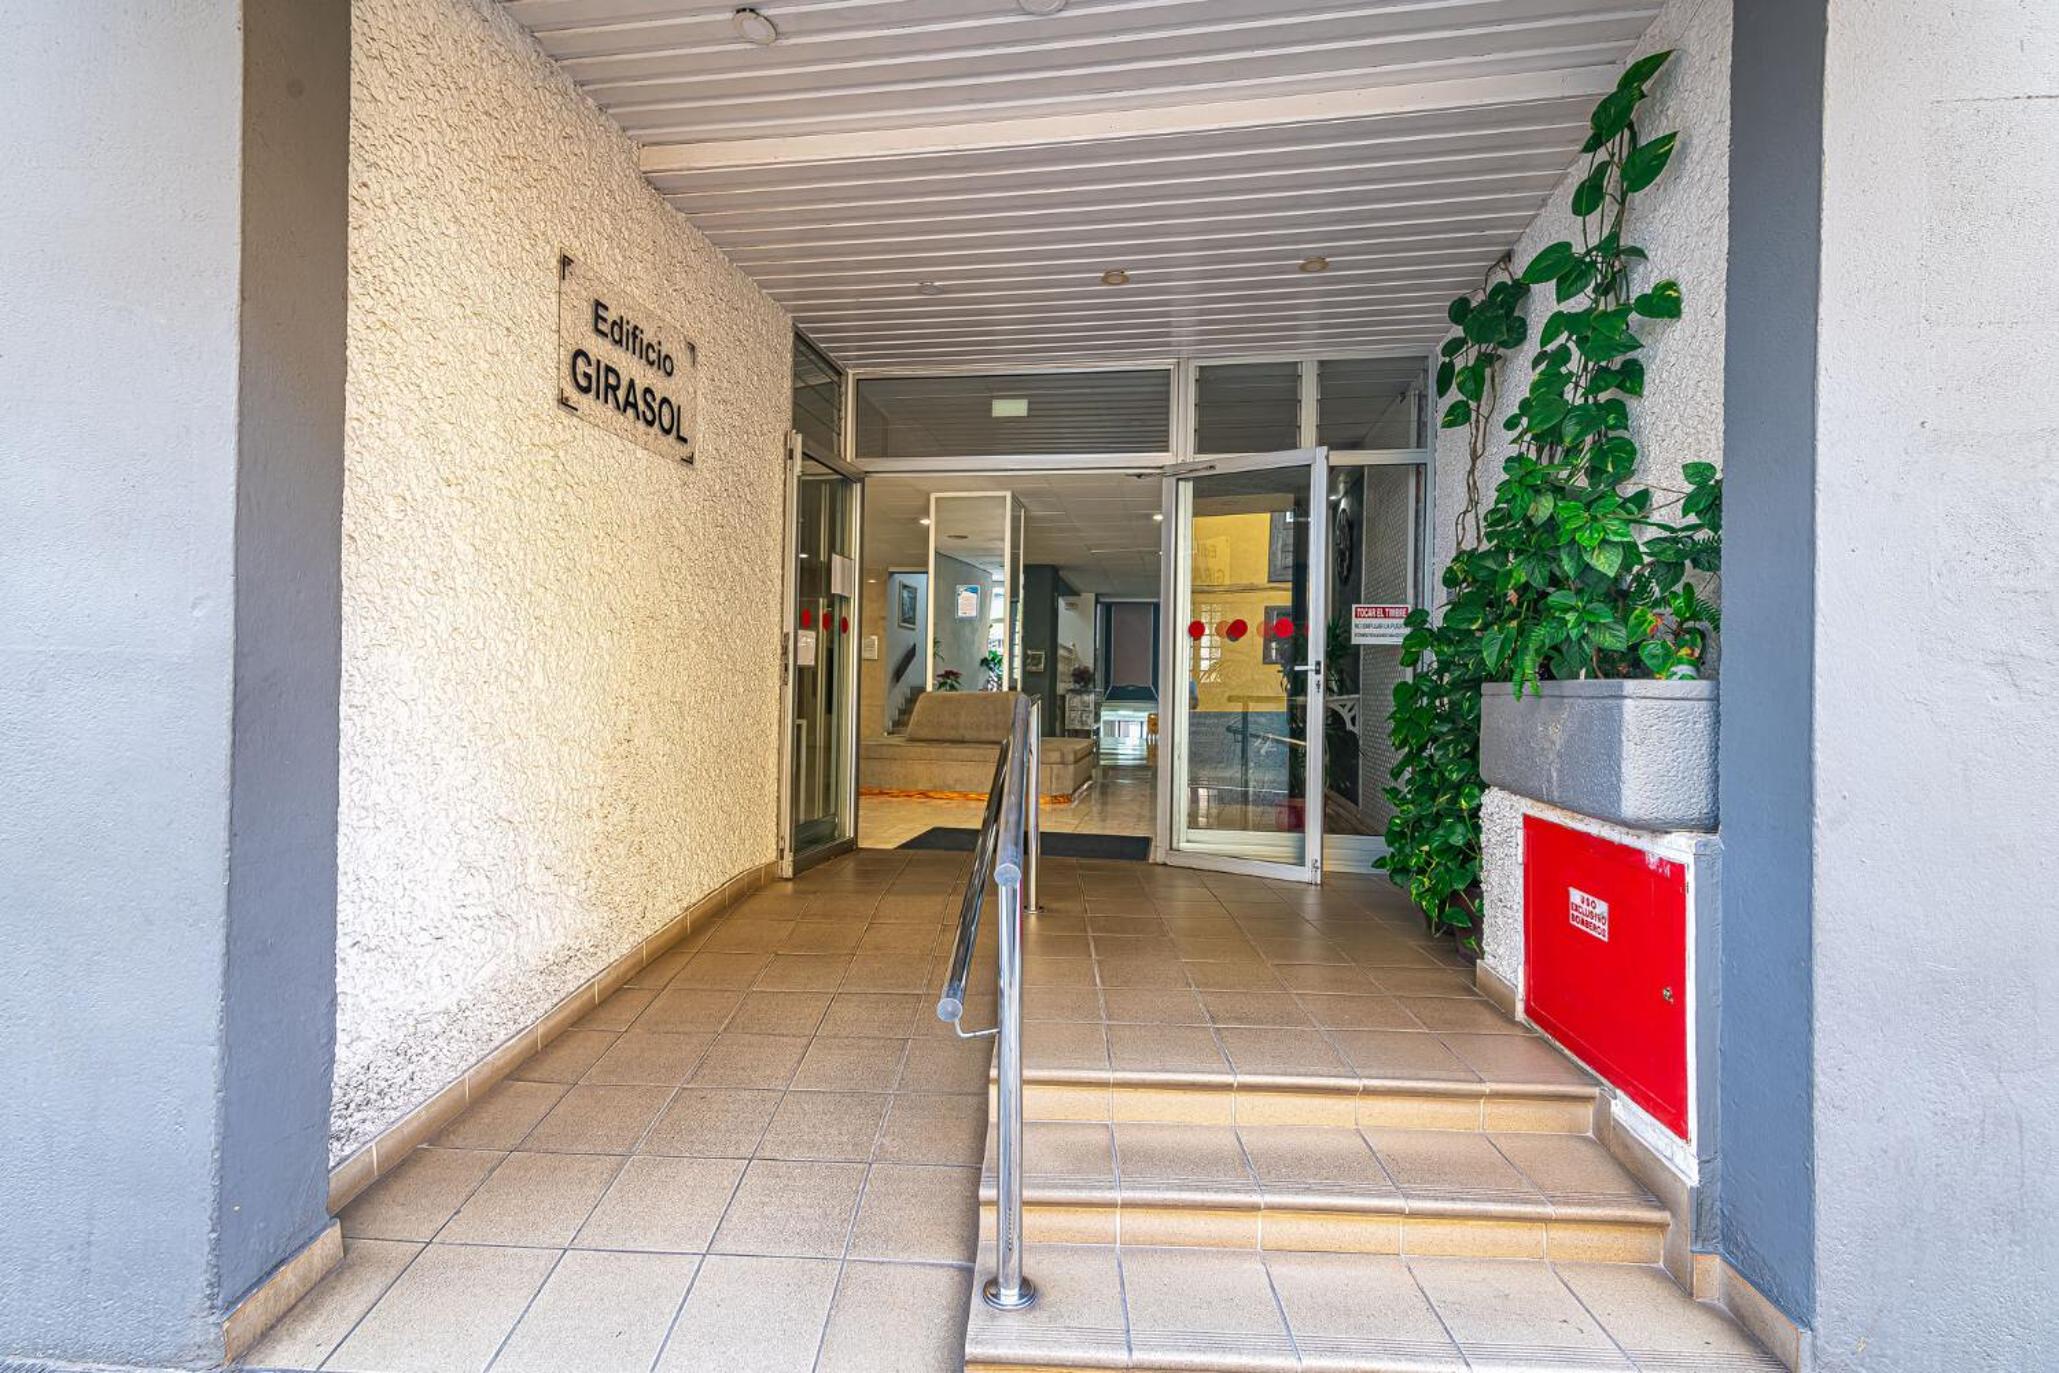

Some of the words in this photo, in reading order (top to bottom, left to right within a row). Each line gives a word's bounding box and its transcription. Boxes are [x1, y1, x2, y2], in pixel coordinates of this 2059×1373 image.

[593, 298, 675, 377] Edificio
[571, 348, 689, 444] GIRASOL
[1357, 608, 1376, 617] TOCAR
[1377, 608, 1384, 617] EL
